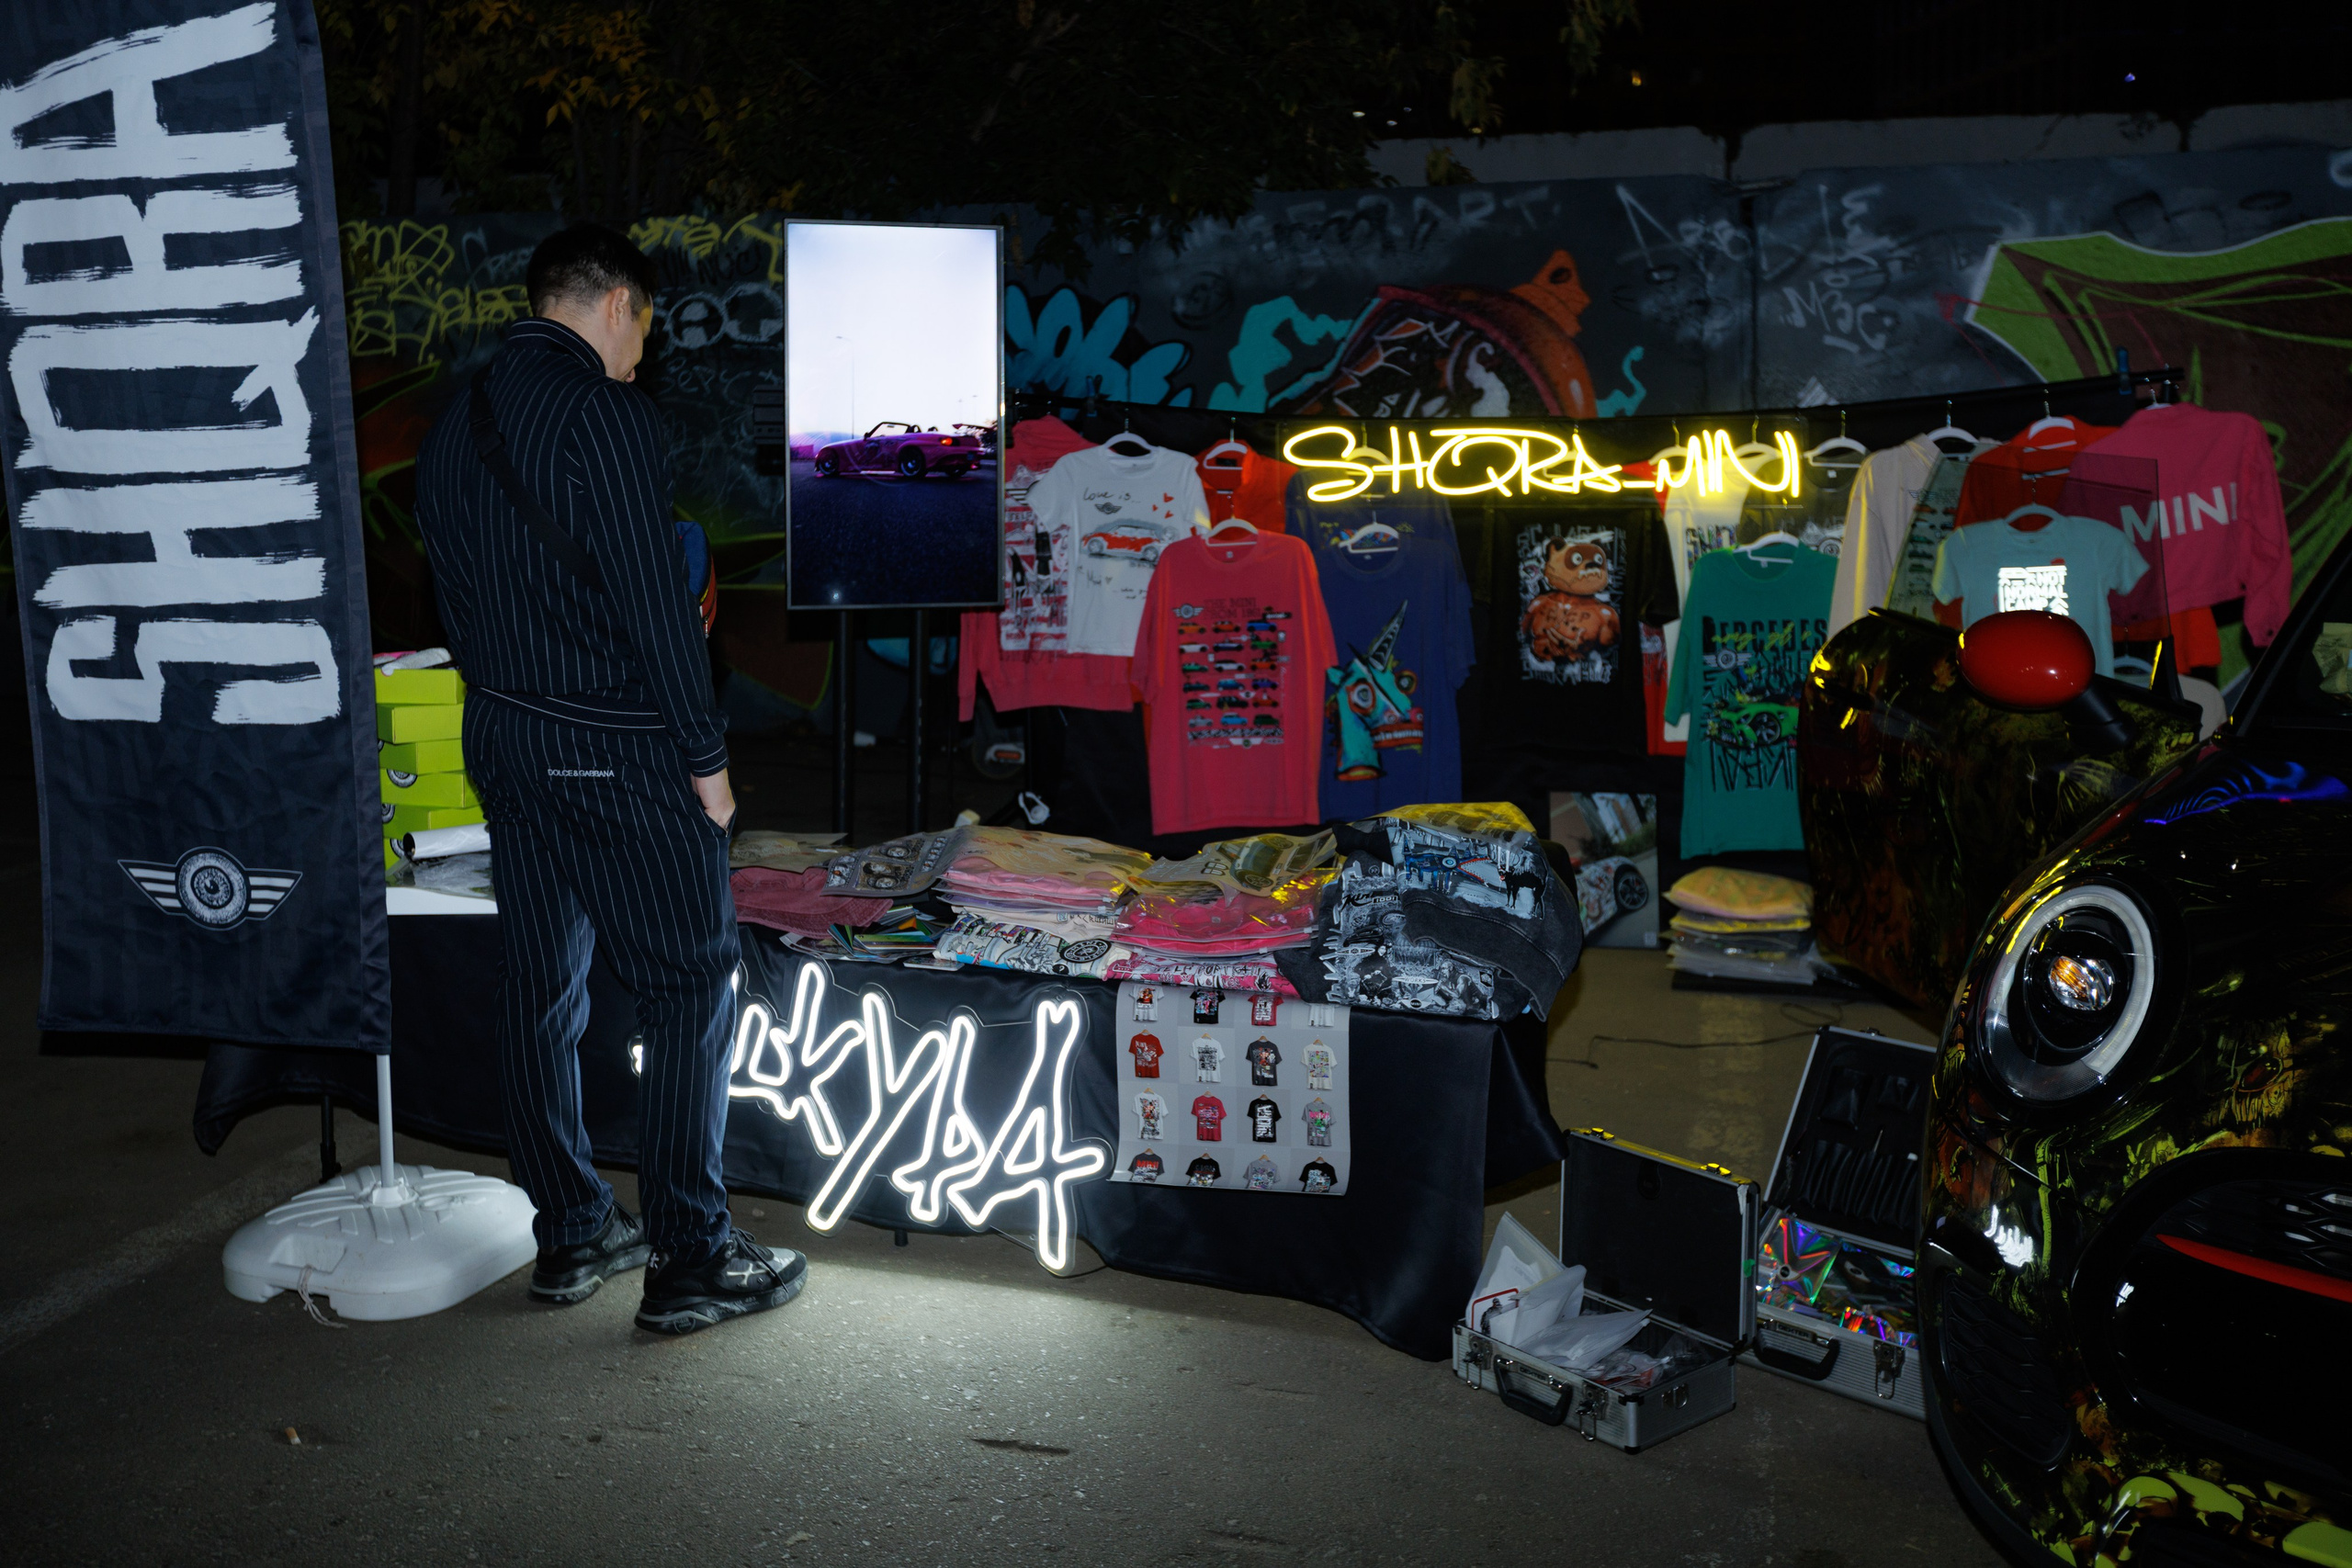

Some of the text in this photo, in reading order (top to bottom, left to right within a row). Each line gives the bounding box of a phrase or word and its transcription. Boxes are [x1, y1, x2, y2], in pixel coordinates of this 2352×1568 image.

[0, 0, 341, 727] SHQRA
[2120, 481, 2237, 544] MINI
[548, 768, 615, 778] DOLCE&GABBANA
